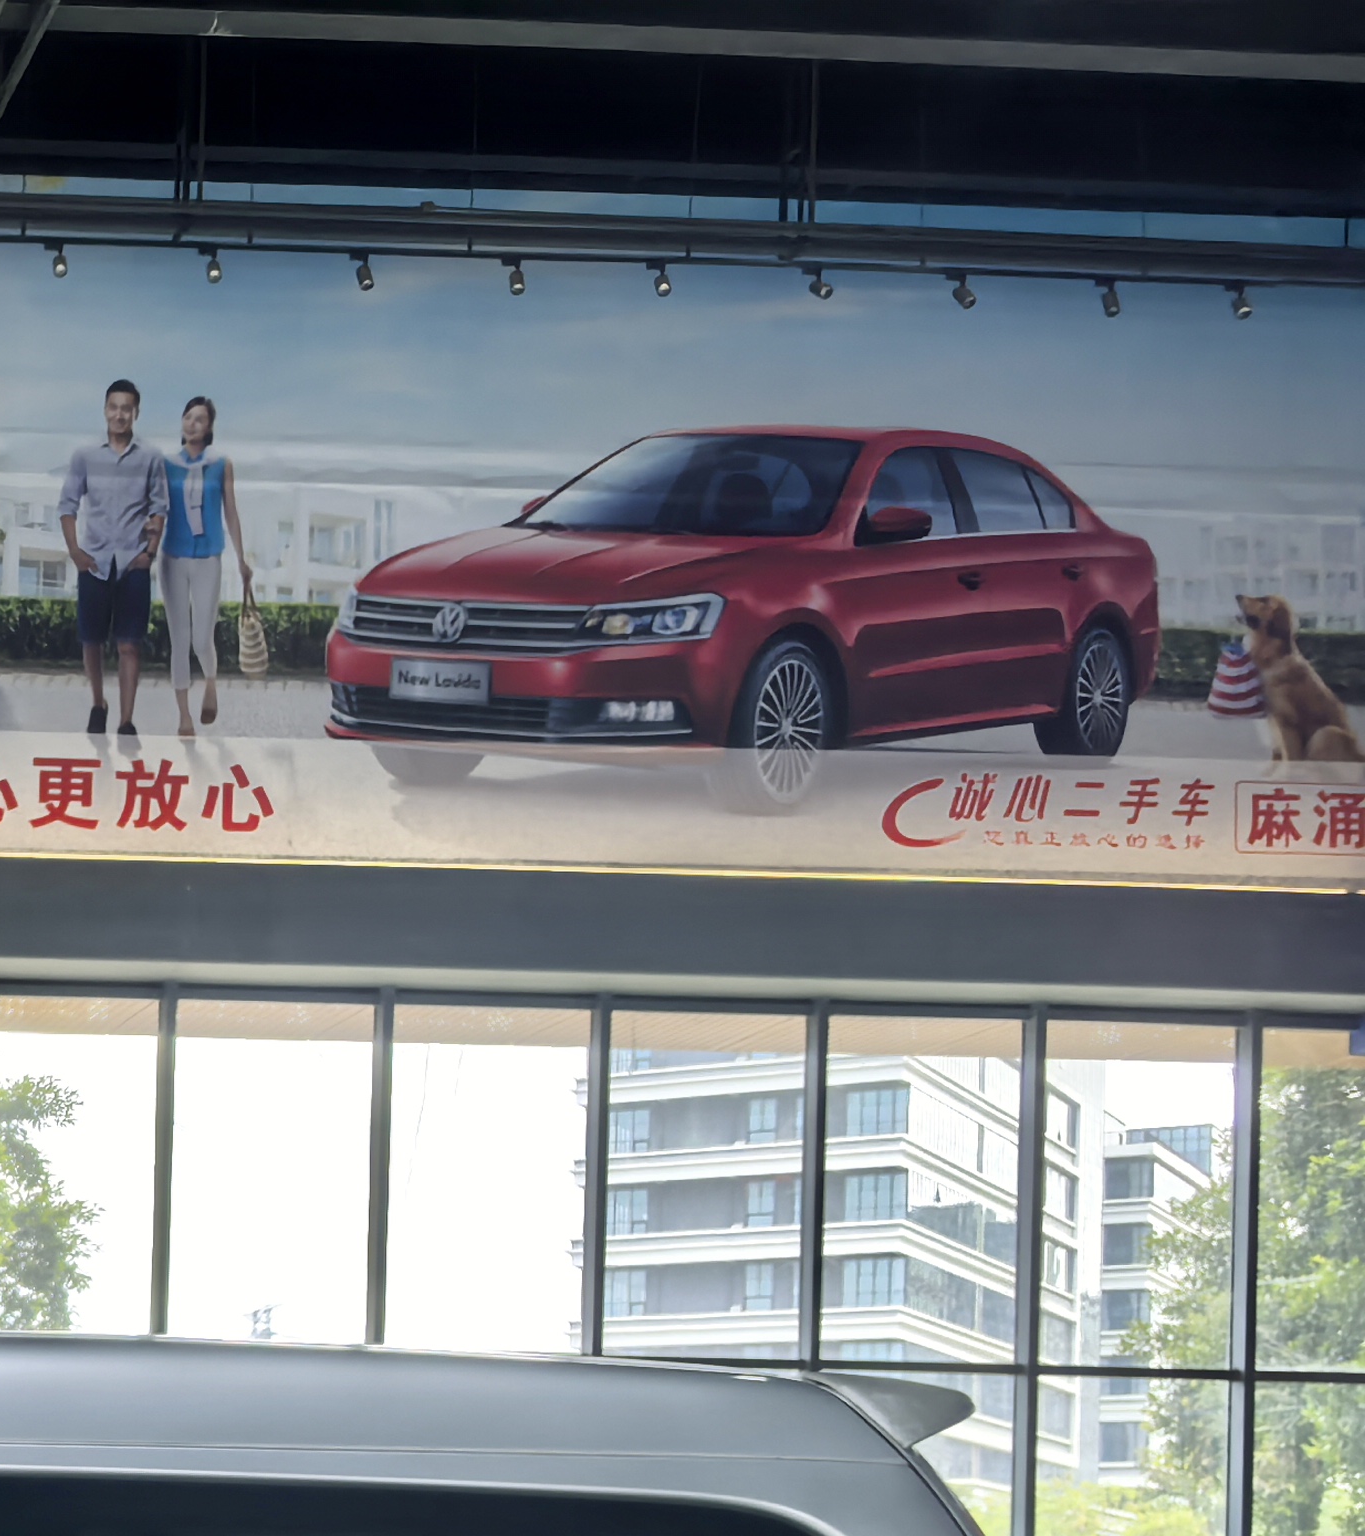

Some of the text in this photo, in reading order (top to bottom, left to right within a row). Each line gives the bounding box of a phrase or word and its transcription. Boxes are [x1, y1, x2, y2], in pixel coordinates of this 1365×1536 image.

[398, 669, 431, 687] New
[948, 772, 1365, 850] 诚心二手车 麻涌
